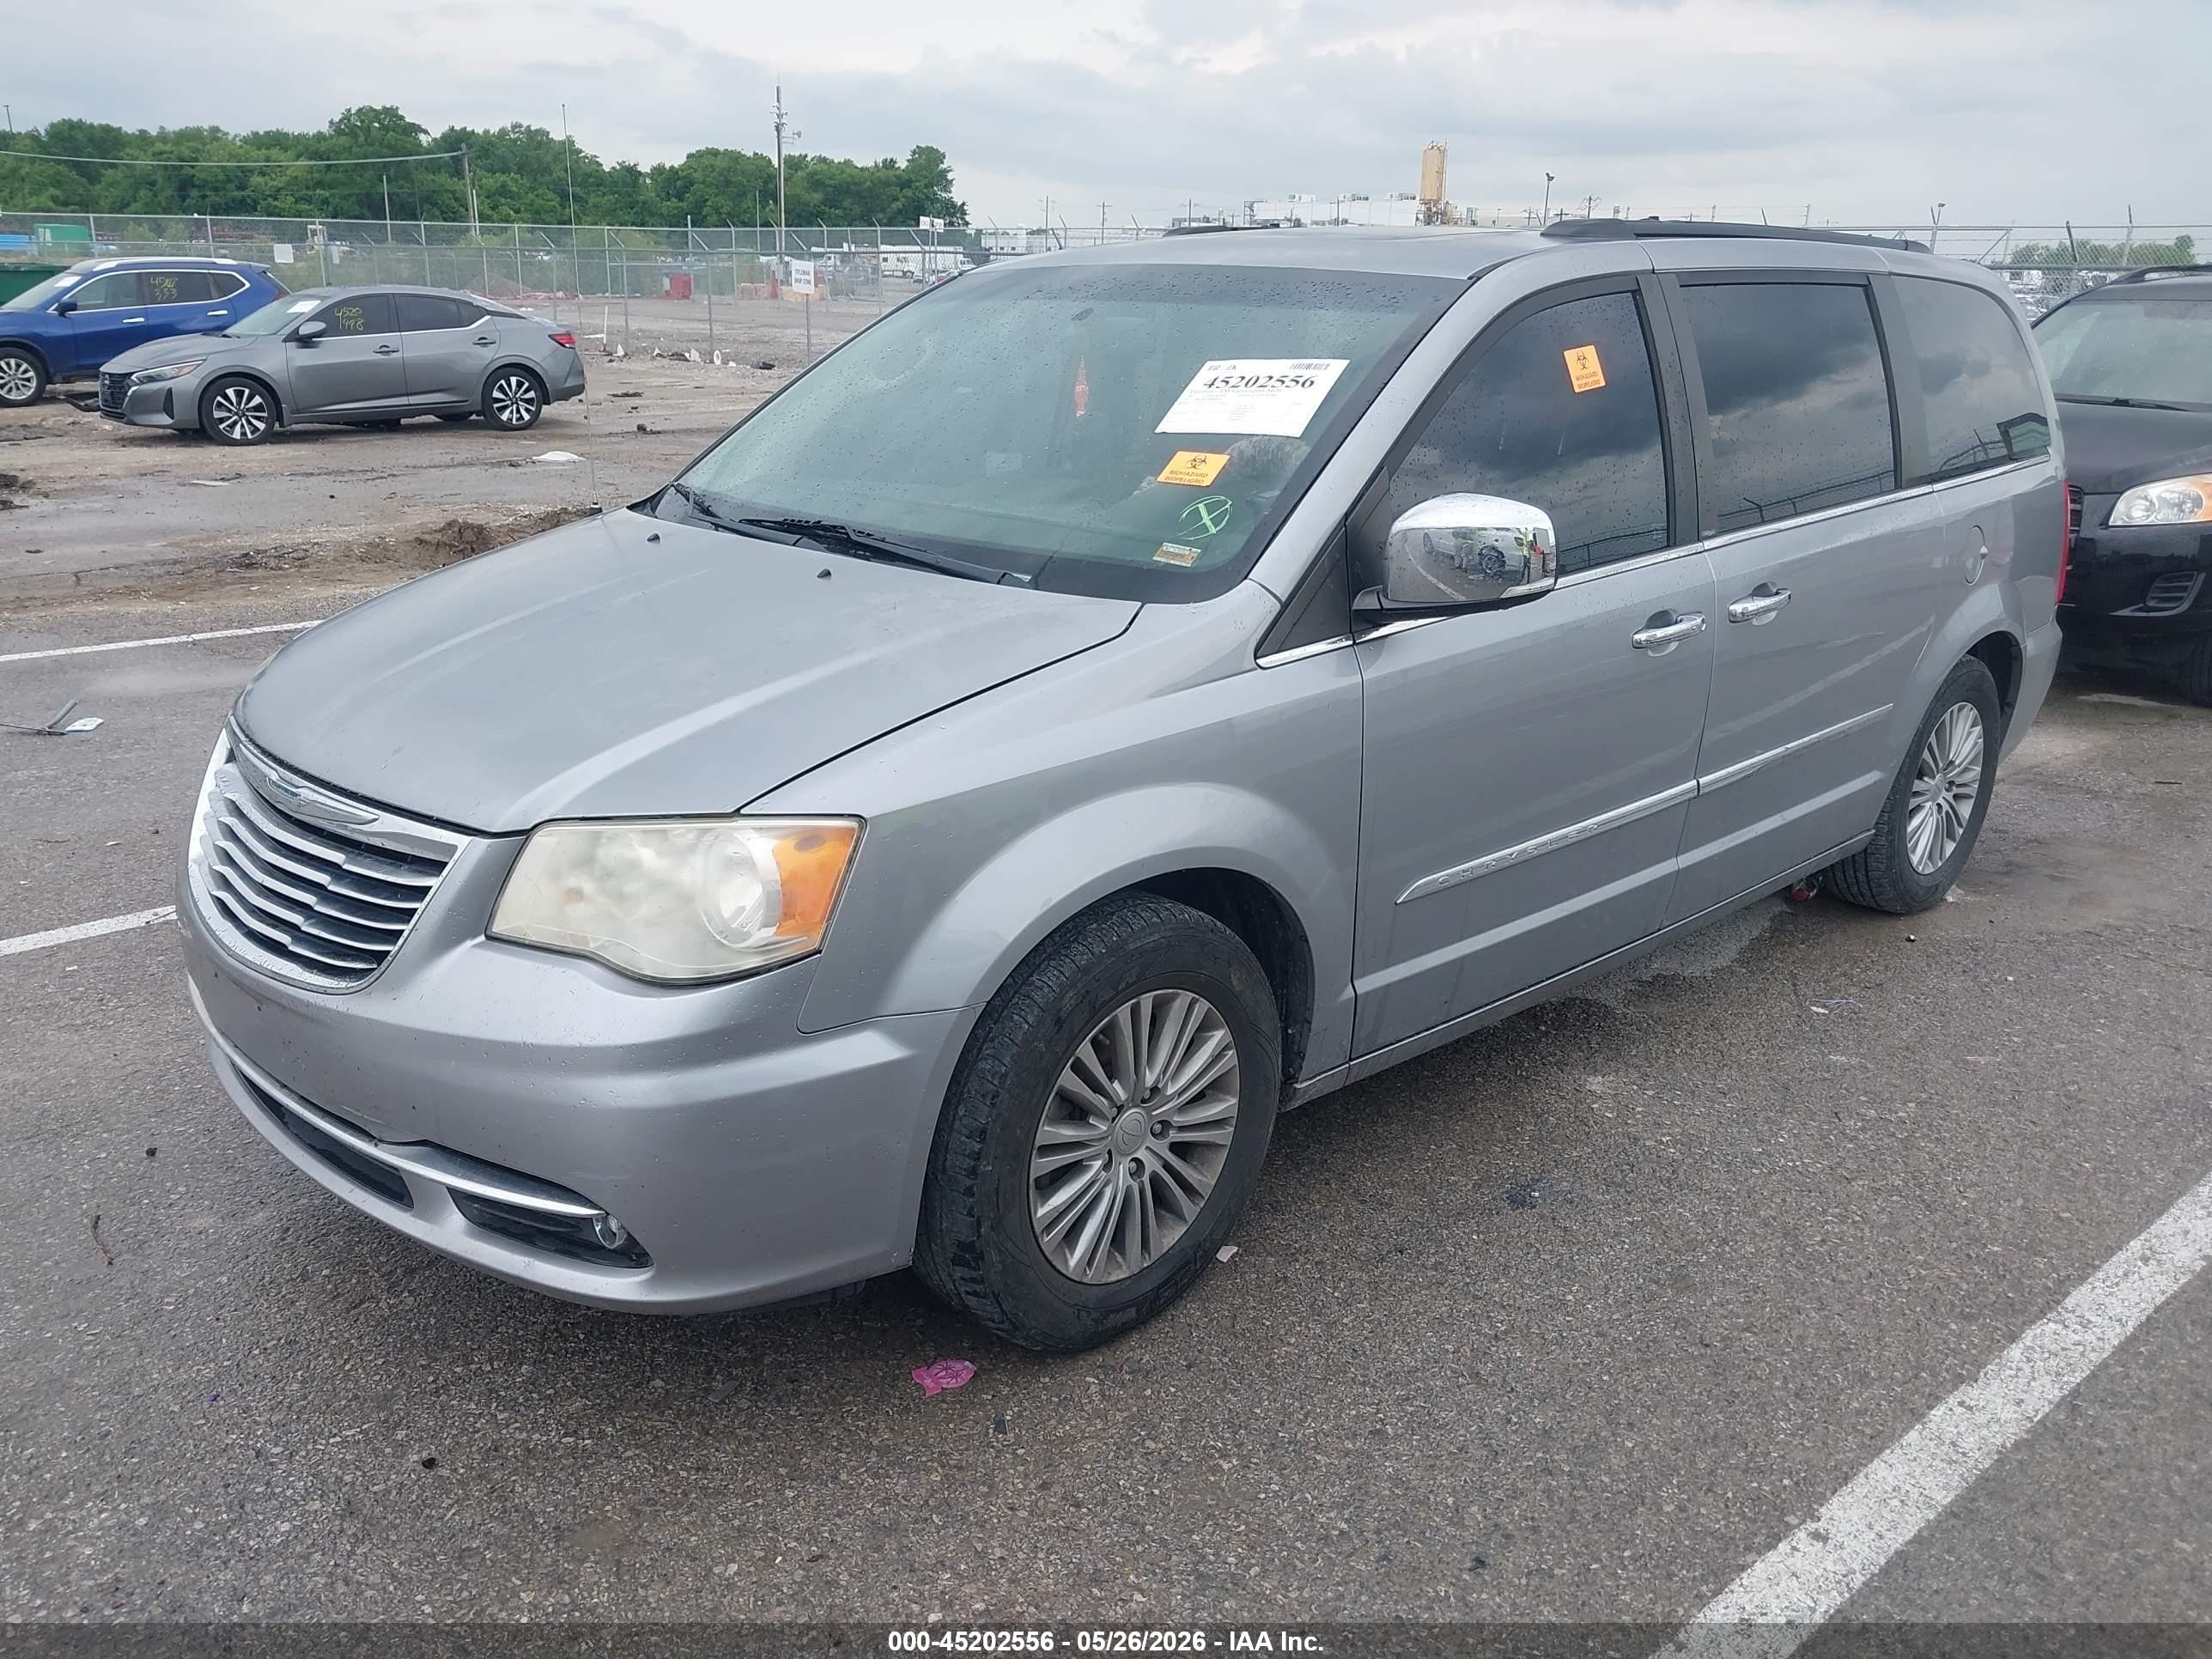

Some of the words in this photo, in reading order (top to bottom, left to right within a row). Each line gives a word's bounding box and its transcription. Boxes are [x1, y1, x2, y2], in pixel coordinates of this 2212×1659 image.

[1203, 374, 1319, 389] 45202556
[1169, 470, 1209, 478] BIOHAZARD
[1164, 476, 1205, 484] BIOPELIGRO
[1436, 823, 1602, 887] CHRYSLER
